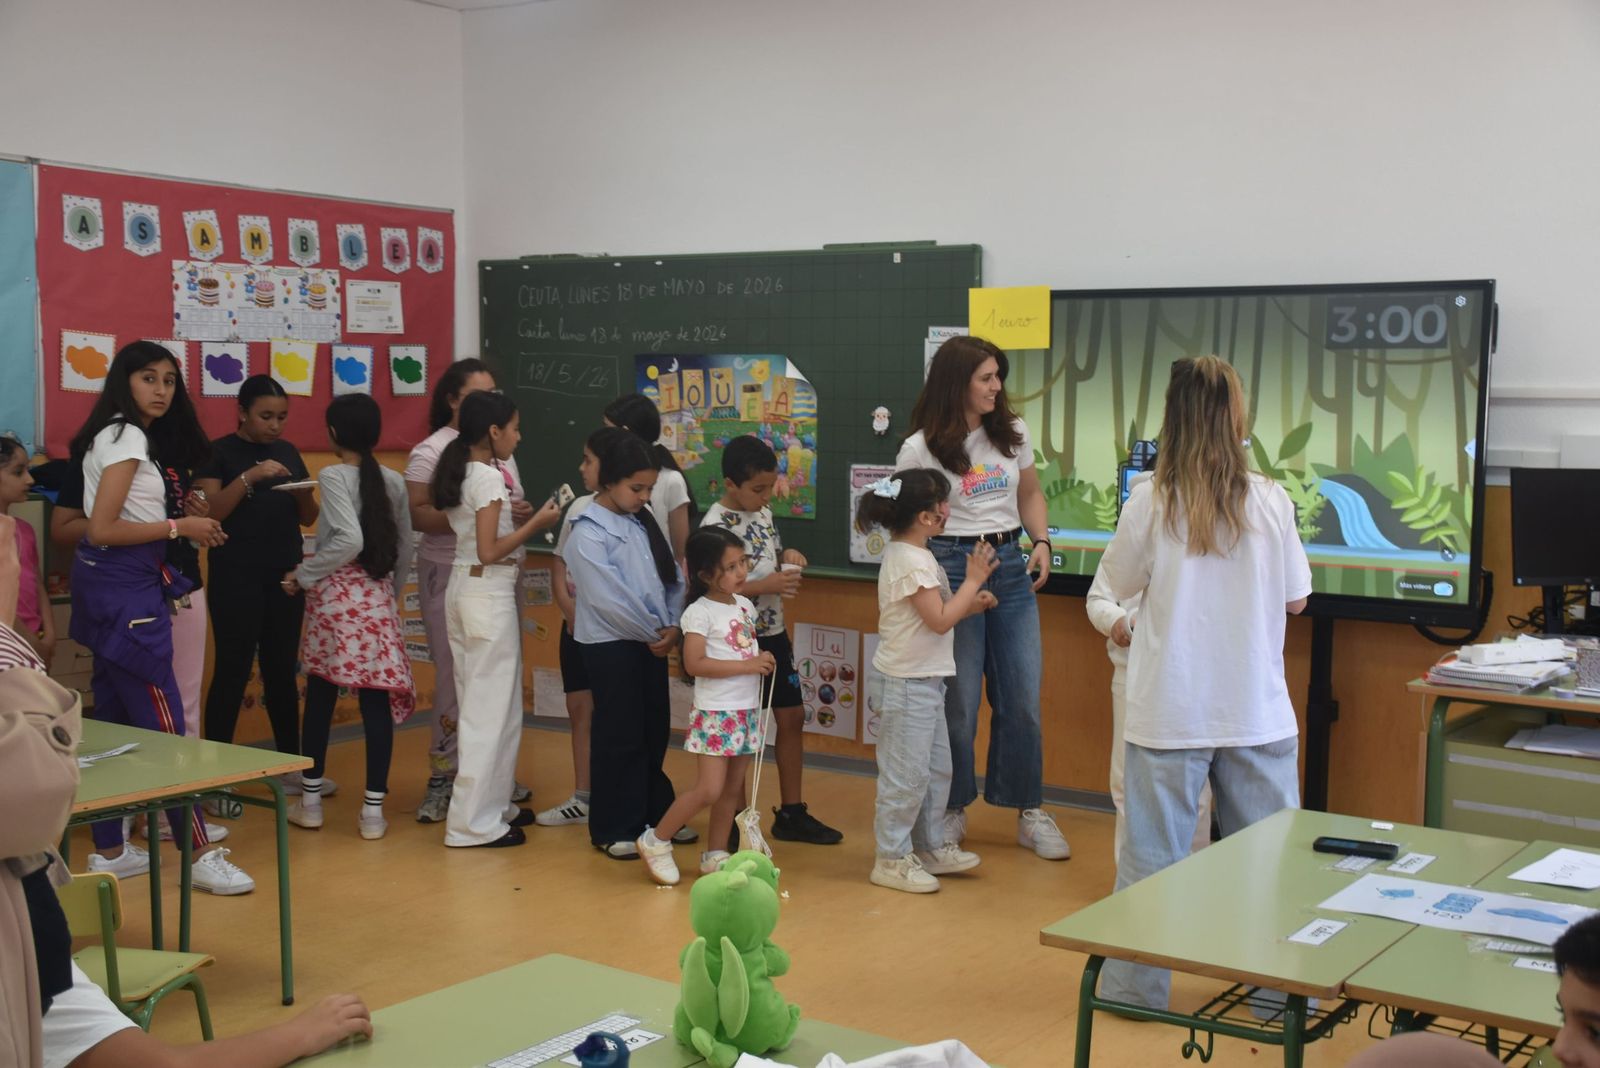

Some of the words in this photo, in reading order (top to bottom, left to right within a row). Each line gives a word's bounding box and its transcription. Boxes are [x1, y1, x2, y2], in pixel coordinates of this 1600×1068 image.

[518, 284, 564, 309] CEUTA,
[568, 283, 610, 305] LUNES
[616, 282, 633, 302] 18
[638, 284, 657, 299] DE
[663, 278, 706, 296] MAYO
[716, 281, 735, 295] DE
[743, 276, 784, 295] 2026
[982, 308, 996, 330] 1
[998, 315, 1039, 328] euro
[1330, 304, 1447, 344] 3:00
[590, 327, 607, 344] 18
[632, 328, 672, 350] mayo
[676, 325, 689, 341] de
[693, 324, 727, 343] 2026
[664, 385, 676, 410] I
[686, 384, 701, 406] O
[715, 382, 731, 405] U
[774, 391, 789, 414] A
[965, 478, 1008, 496] Cultural
[816, 632, 825, 652] U
[831, 644, 840, 655] u
